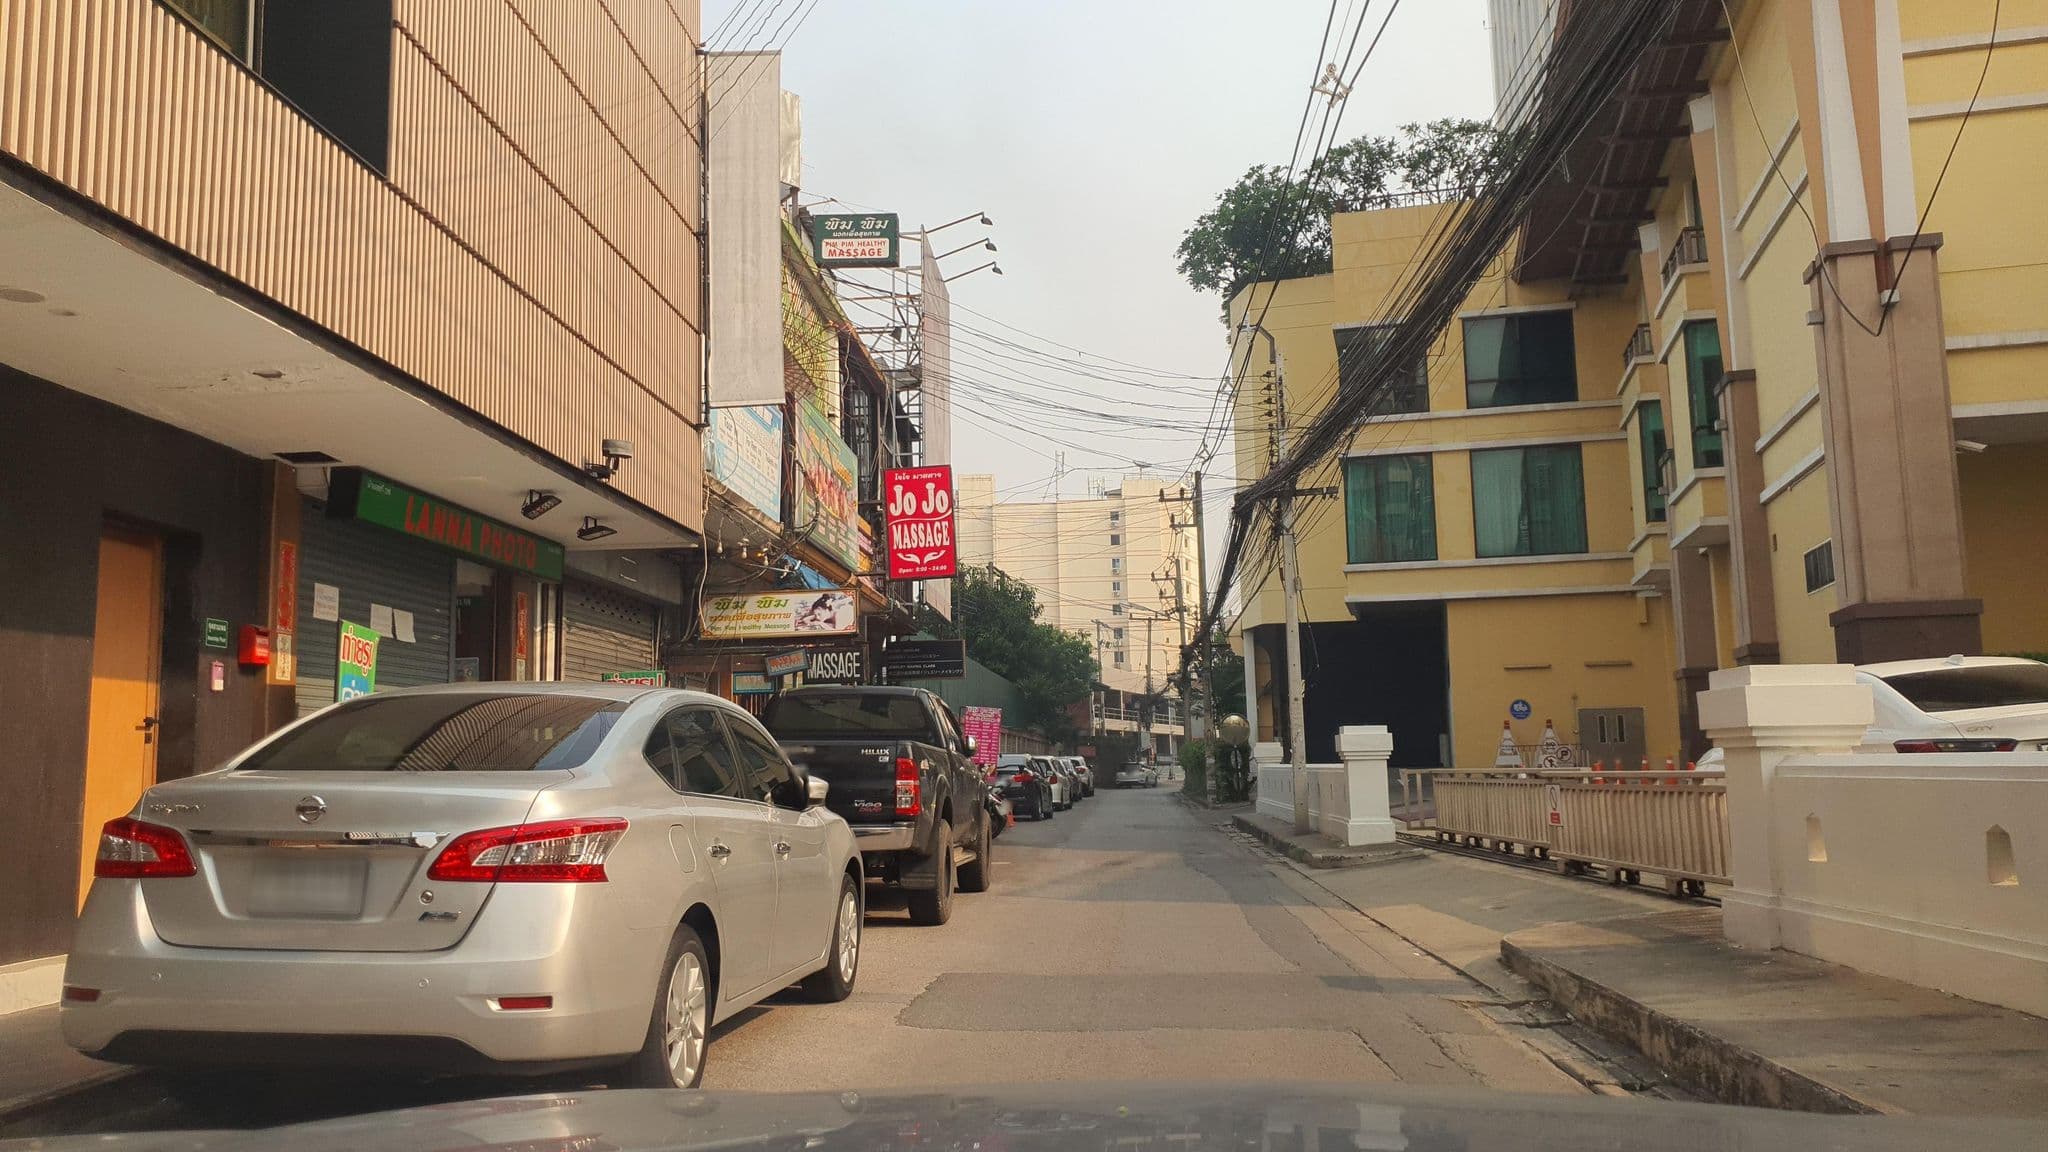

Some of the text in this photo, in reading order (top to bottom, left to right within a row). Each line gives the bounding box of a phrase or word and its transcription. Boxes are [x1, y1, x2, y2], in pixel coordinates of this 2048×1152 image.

[825, 217, 889, 230] พิม พิม
[828, 248, 882, 257] MASSAGE
[889, 482, 949, 517] Jo Jo
[404, 495, 538, 570] LANNA PHOTO
[892, 521, 950, 550] MASSAGE
[714, 596, 789, 611] พิม พิม
[807, 651, 860, 679] MASSAGE
